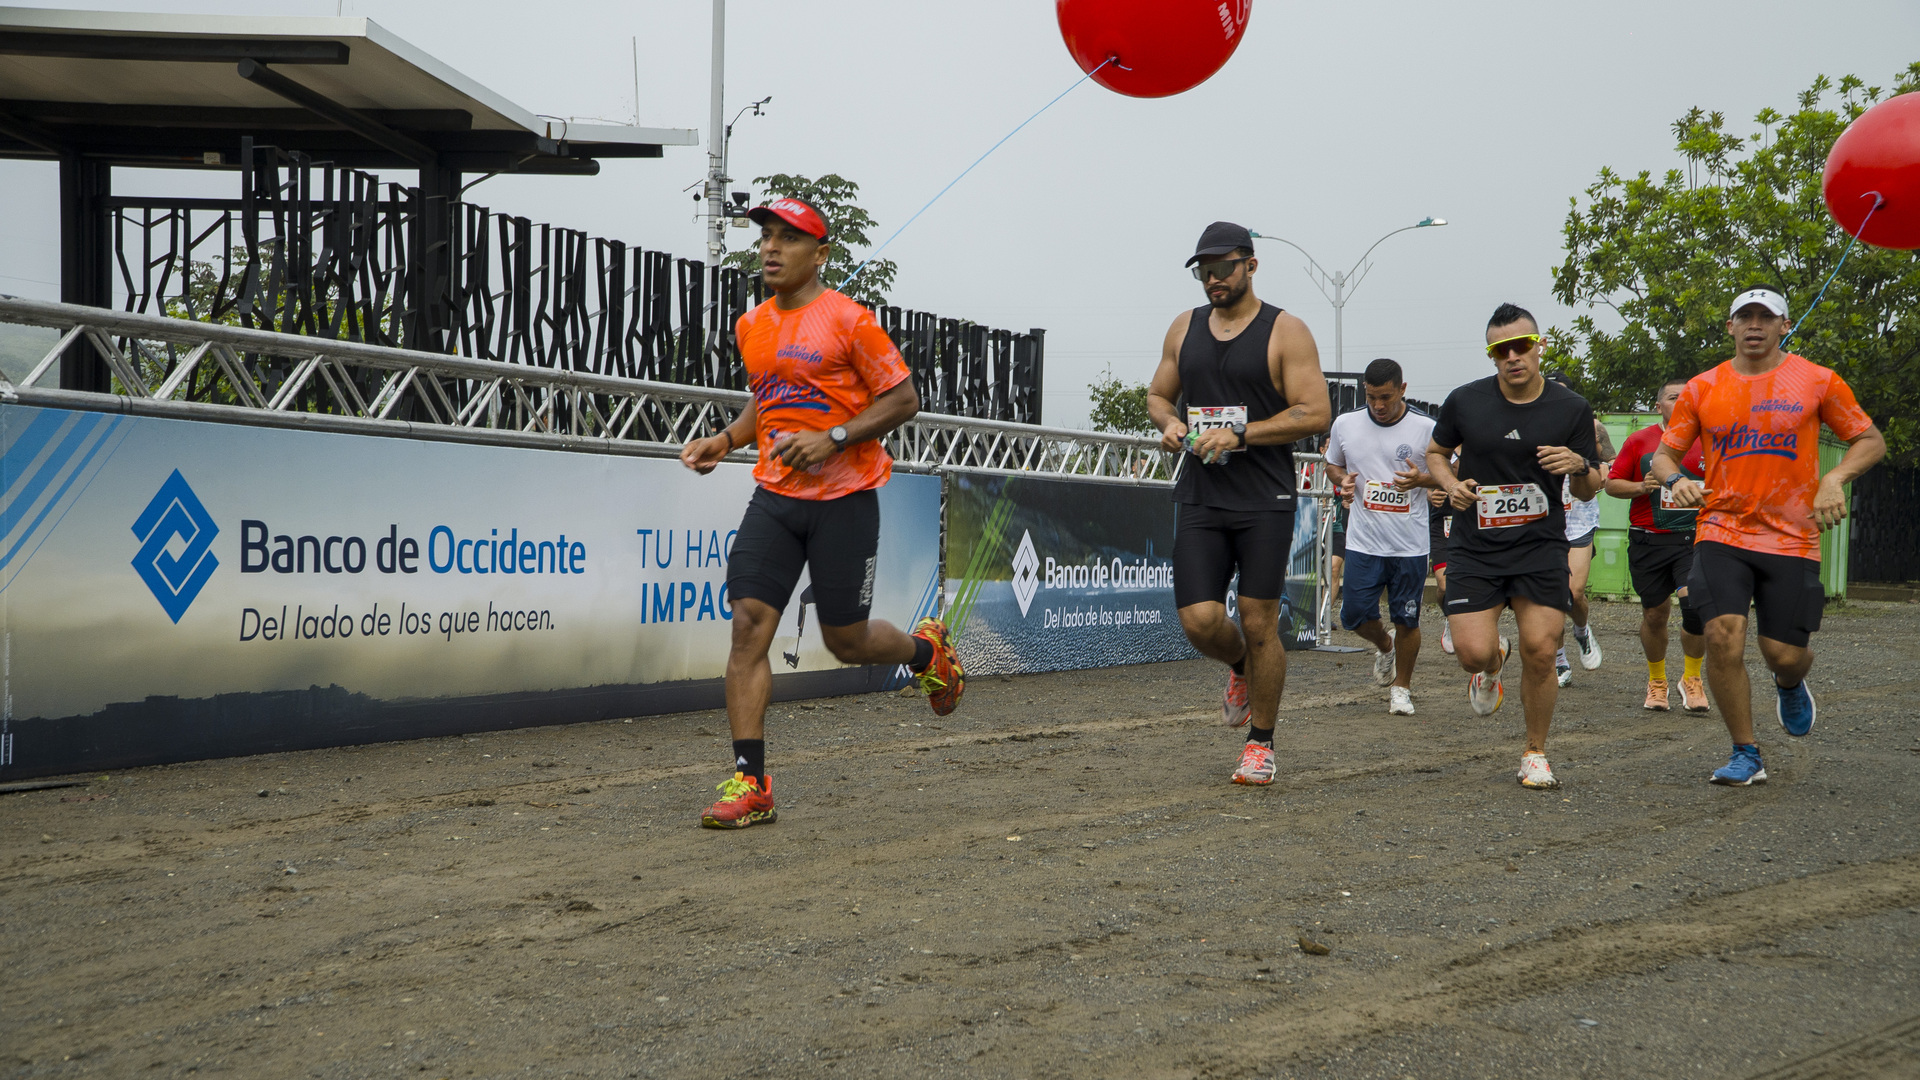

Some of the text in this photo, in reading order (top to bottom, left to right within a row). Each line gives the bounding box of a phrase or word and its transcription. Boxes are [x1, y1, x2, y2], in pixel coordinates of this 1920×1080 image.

[1218, 2, 1235, 40] MIN
[1712, 429, 1797, 457] Muñeca
[1730, 422, 1748, 435] La
[1371, 490, 1404, 504] 2005
[1495, 497, 1530, 514] 264
[241, 520, 586, 574] Banco de Occidente
[637, 529, 738, 569] TU HAC
[1045, 557, 1174, 589] Banco de Occidente
[641, 581, 733, 624] IMPAC
[1044, 604, 1162, 629] Del lado de los que hacen.
[240, 601, 555, 642] Del lado de los que hacen.
[1297, 629, 1317, 641] AVAL
